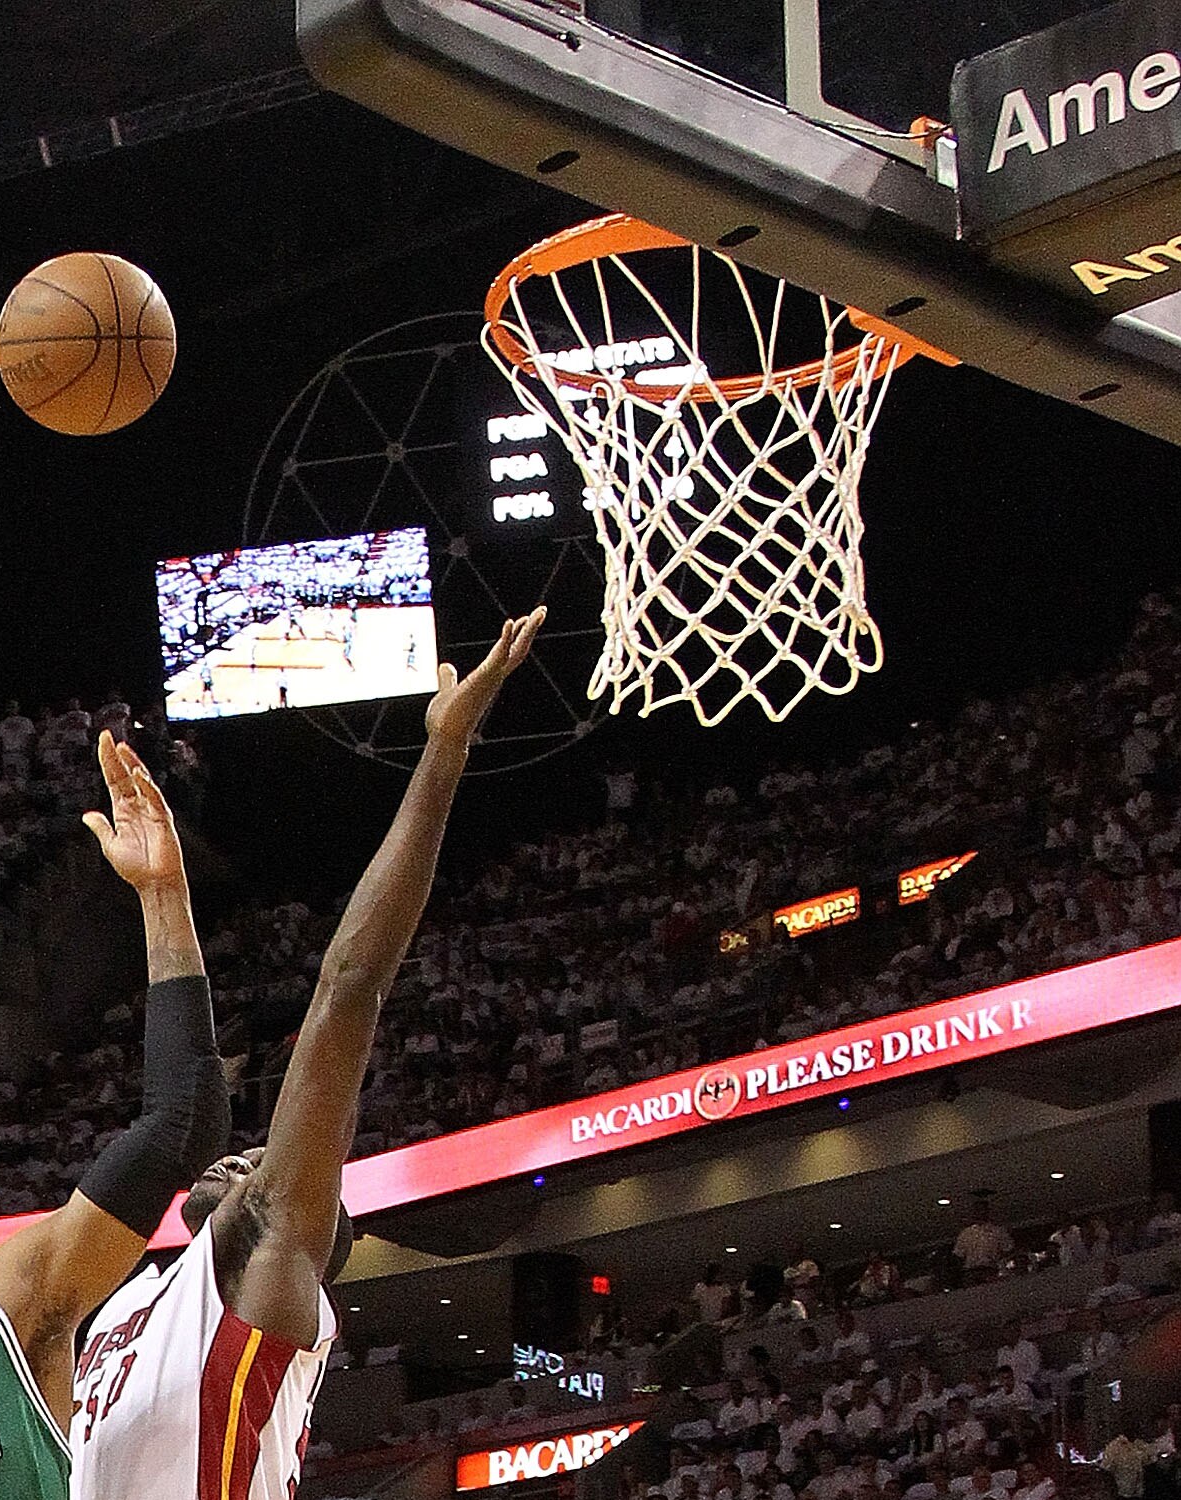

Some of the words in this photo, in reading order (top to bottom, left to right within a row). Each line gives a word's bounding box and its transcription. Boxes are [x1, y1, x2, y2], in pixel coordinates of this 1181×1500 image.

[986, 51, 1181, 173] Ame
[571, 1087, 692, 1143] BACARDI
[745, 1039, 876, 1099] PLEASE
[881, 1004, 1003, 1064] DRINK
